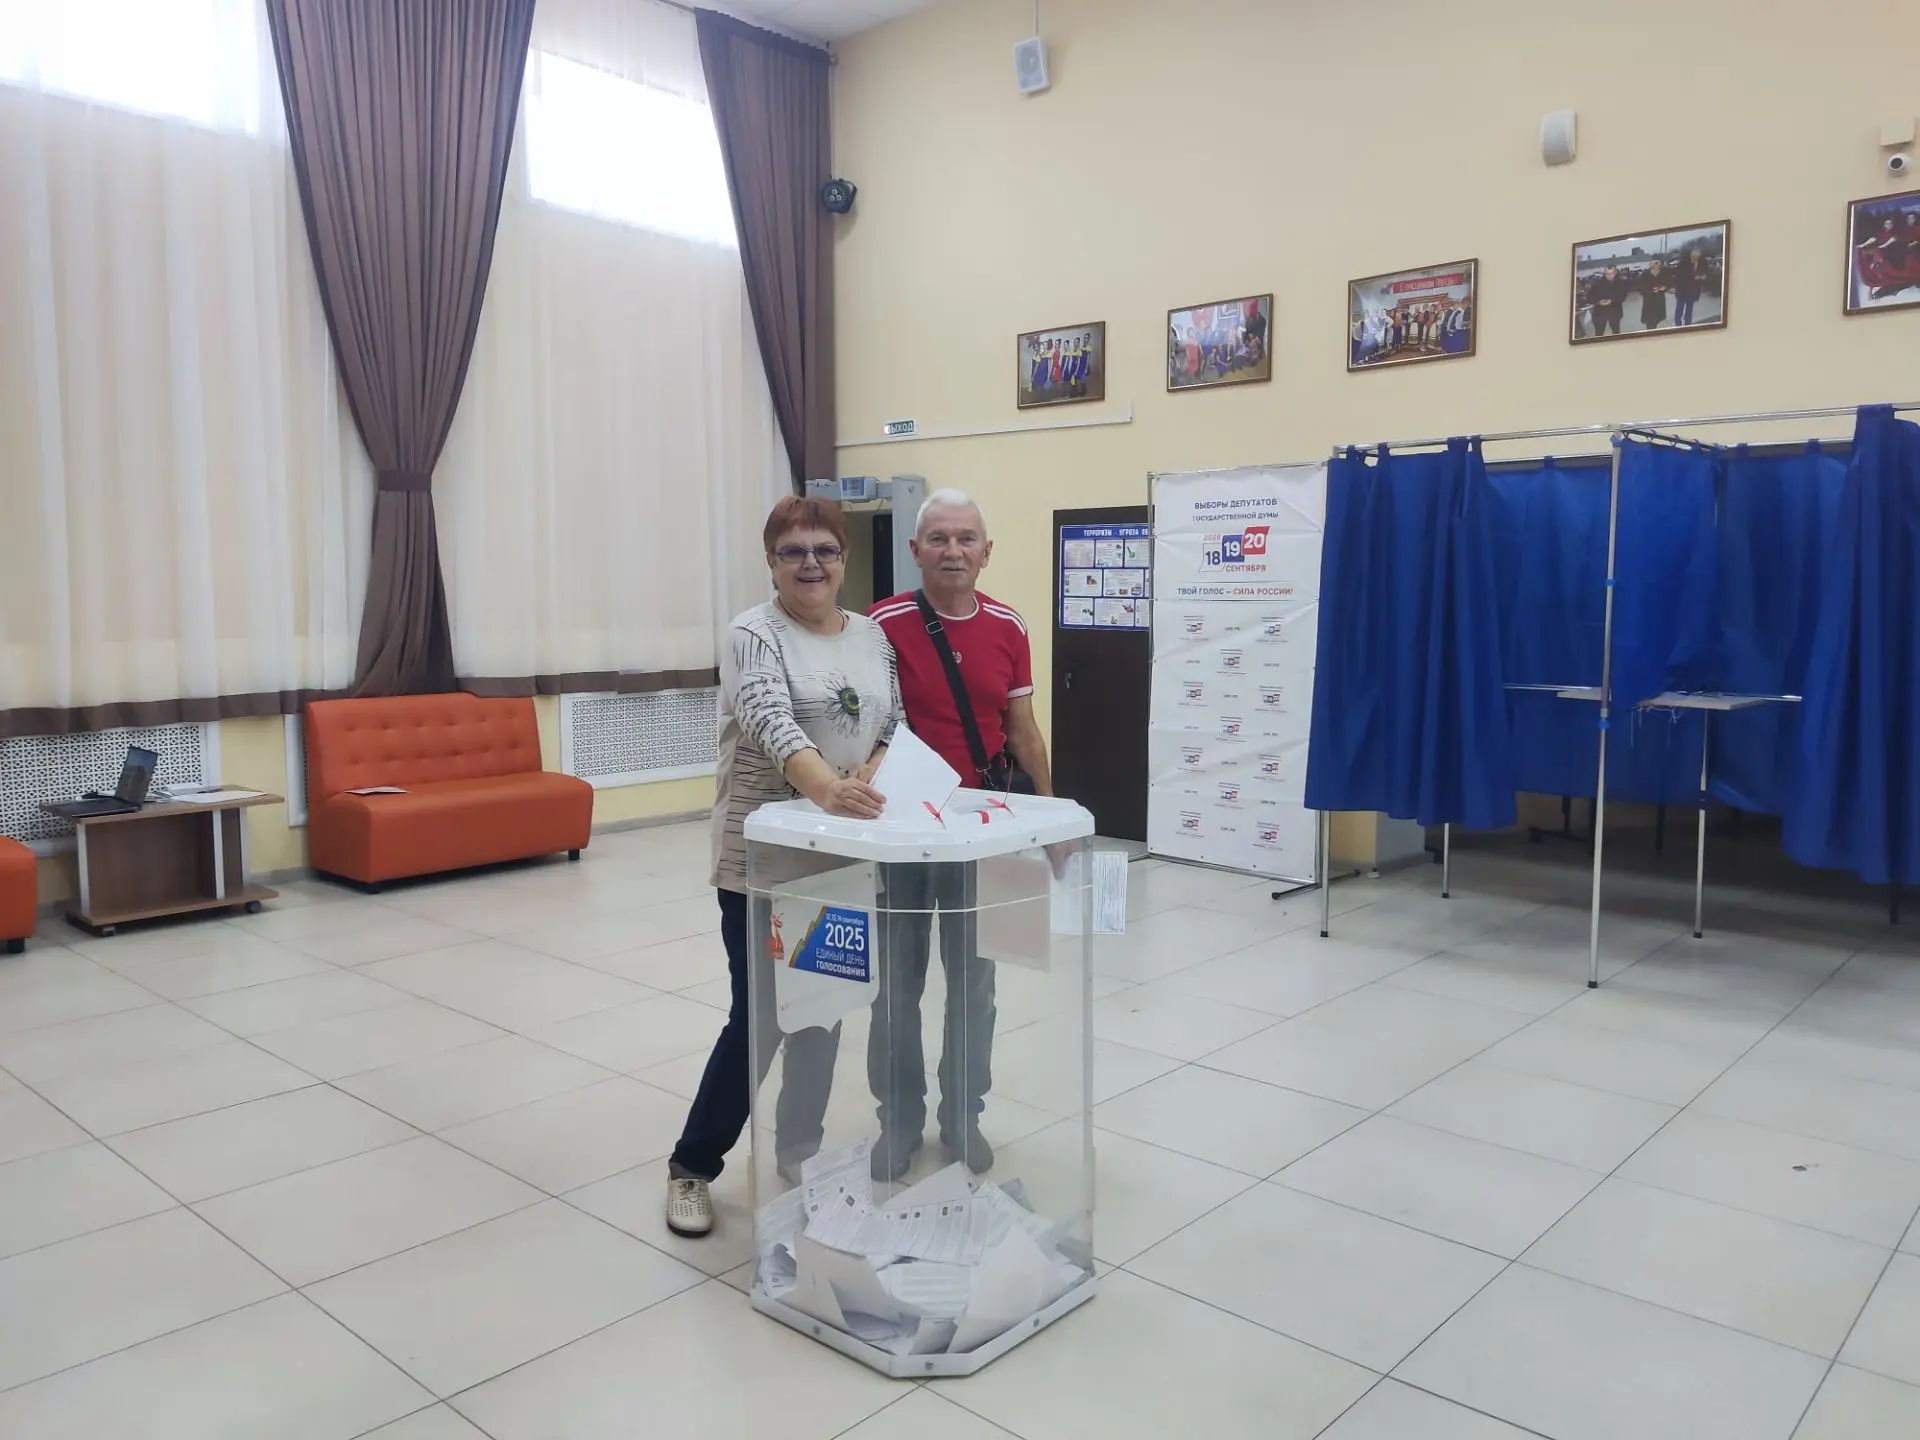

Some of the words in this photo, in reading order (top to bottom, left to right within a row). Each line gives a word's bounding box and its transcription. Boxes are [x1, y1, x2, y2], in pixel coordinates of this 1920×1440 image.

[1195, 500, 1229, 510] ВЫБОРЫ
[1230, 498, 1277, 509] ДЕПУТАТОВ
[1257, 512, 1279, 520] ДУМЫ
[1205, 551, 1221, 565] 18
[1224, 541, 1240, 557] 19
[1244, 533, 1265, 549] 20
[1178, 586, 1197, 595] ТВОЙ
[825, 922, 864, 951] 2025
[816, 947, 845, 962] ЕДИНЫЙ
[846, 953, 865, 965] ДЕНЬ
